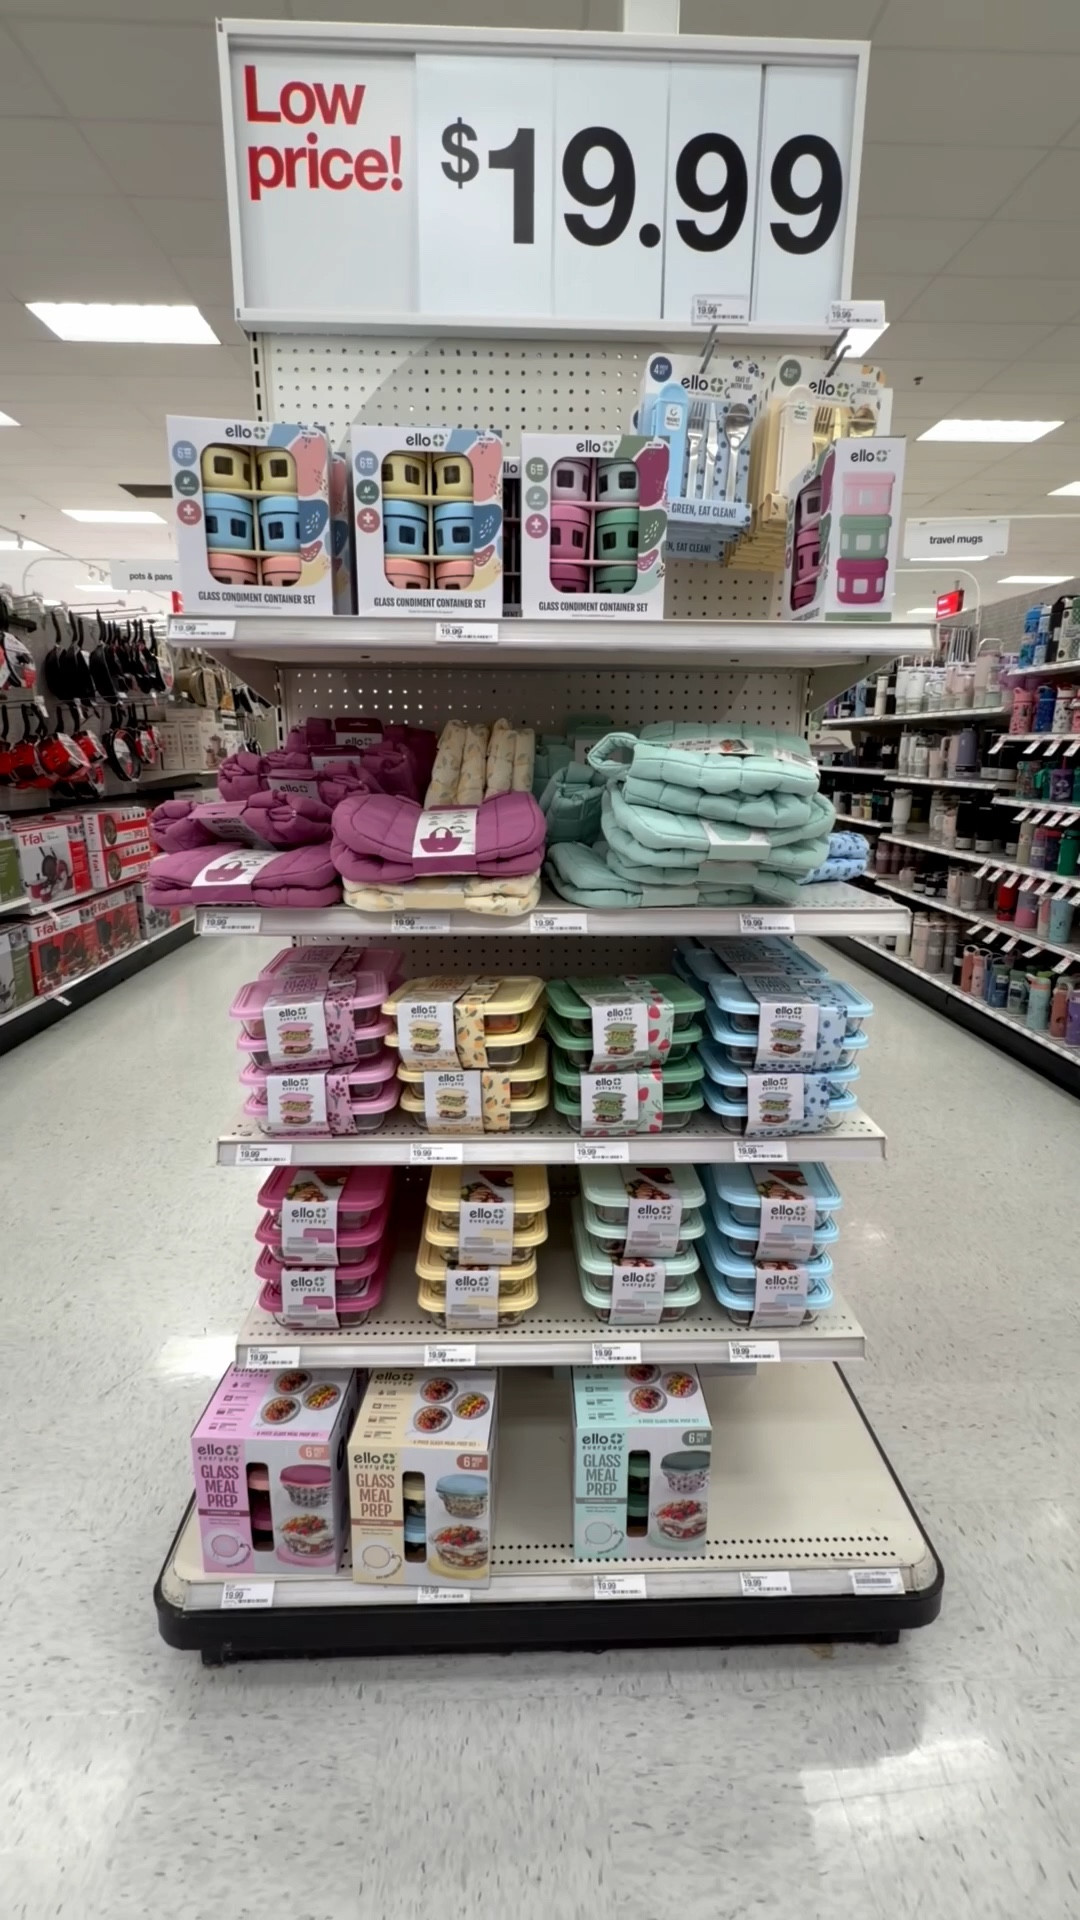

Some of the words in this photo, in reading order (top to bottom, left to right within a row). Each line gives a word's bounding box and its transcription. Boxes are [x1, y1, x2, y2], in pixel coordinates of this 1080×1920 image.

[244, 65, 366, 126] Low
[247, 132, 404, 201] price!
[440, 116, 843, 255] $19.99
[697, 306, 717, 314] 19.99
[832, 310, 852, 319] 19.99
[680, 374, 708, 391] ello
[809, 379, 835, 396] ello
[225, 424, 252, 438] ello
[406, 433, 431, 447] ello
[576, 440, 601, 453] ello
[850, 450, 874, 463] ello
[502, 462, 518, 473] llo
[671, 503, 696, 517] GREEN,
[698, 506, 713, 517] EAT
[714, 506, 736, 519] CLEAN!
[929, 534, 955, 544] travel
[957, 535, 983, 546] mugs
[675, 542, 688, 552] EAT
[689, 543, 711, 554] CLEAN!
[129, 572, 146, 582] pots
[147, 572, 153, 580] &
[154, 573, 173, 582] pans
[198, 591, 220, 601] GLASS
[222, 592, 262, 603] CONDIMENT
[264, 594, 302, 604] CONTAINER
[303, 595, 316, 605] SET
[374, 597, 395, 607] GLASS
[396, 598, 435, 608] CONDIMENT
[436, 598, 472, 608] CONTAINER
[474, 599, 486, 608] SET
[538, 601, 559, 612] GLASS
[560, 602, 598, 612] CONDIMENT
[599, 602, 635, 612] CONTAINER
[636, 603, 648, 612] SET
[345, 737, 363, 746] ello
[280, 784, 299, 792] ello
[279, 1008, 297, 1018] ello
[411, 1006, 429, 1015] ello
[607, 1008, 623, 1018] ello
[775, 1006, 793, 1015] ello
[282, 1079, 299, 1087] ello
[291, 1208, 314, 1218] ello
[469, 1208, 492, 1219] ello
[638, 1205, 660, 1215] ello
[771, 1205, 794, 1216] ello
[291, 1277, 313, 1287] ello
[455, 1276, 477, 1286] ello
[622, 1272, 644, 1282] ello
[765, 1276, 787, 1285] ello
[376, 1372, 400, 1380] ello
[582, 1433, 608, 1444] ello
[688, 1433, 695, 1444] 6
[198, 1444, 224, 1456] ello
[305, 1447, 312, 1458] 6
[354, 1452, 381, 1464] ello
[464, 1457, 470, 1467] 6
[584, 1454, 621, 1468] GLASS
[201, 1465, 239, 1479] GLASS
[586, 1468, 618, 1482] MEAL
[356, 1473, 395, 1488] GLASS
[205, 1480, 238, 1494] MEAL
[586, 1482, 617, 1496] PREP
[207, 1494, 238, 1508] PREP
[360, 1488, 393, 1503] MEAL
[361, 1503, 392, 1517] PREP
